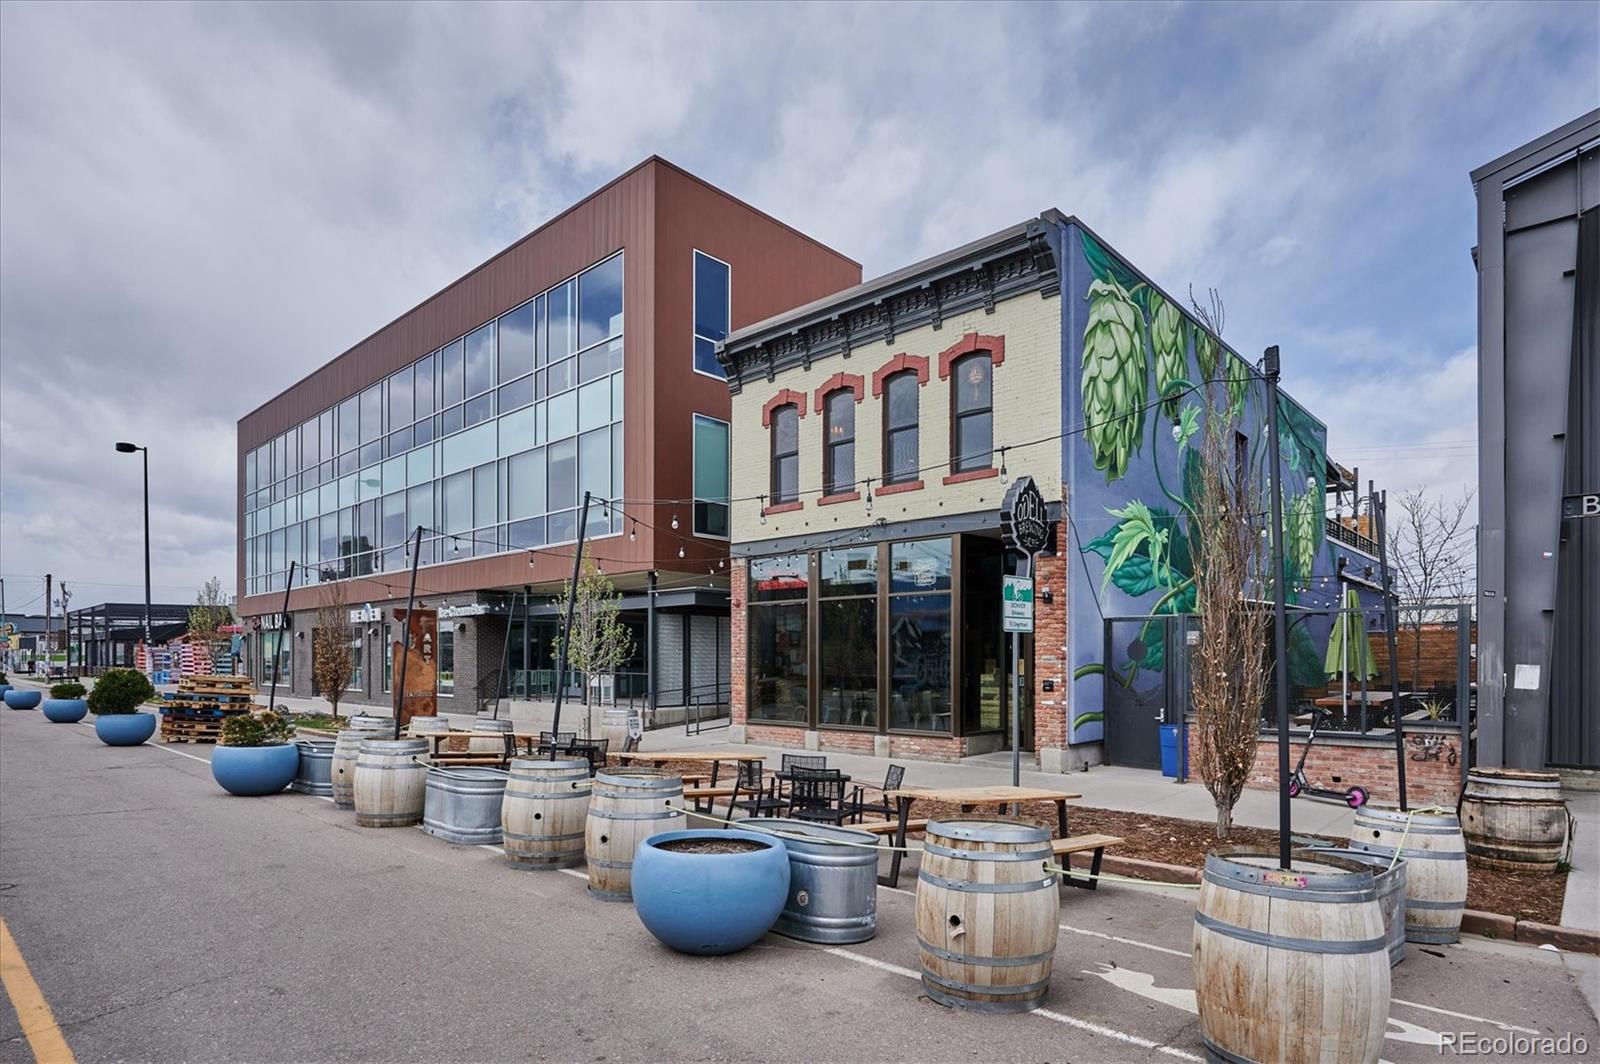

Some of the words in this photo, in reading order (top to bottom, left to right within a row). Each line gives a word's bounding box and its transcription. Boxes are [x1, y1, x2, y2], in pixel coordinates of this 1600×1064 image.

[1017, 490, 1044, 527] ODELL
[1019, 521, 1044, 539] BREWING
[261, 614, 274, 630] NAIL
[423, 632, 432, 666] ART
